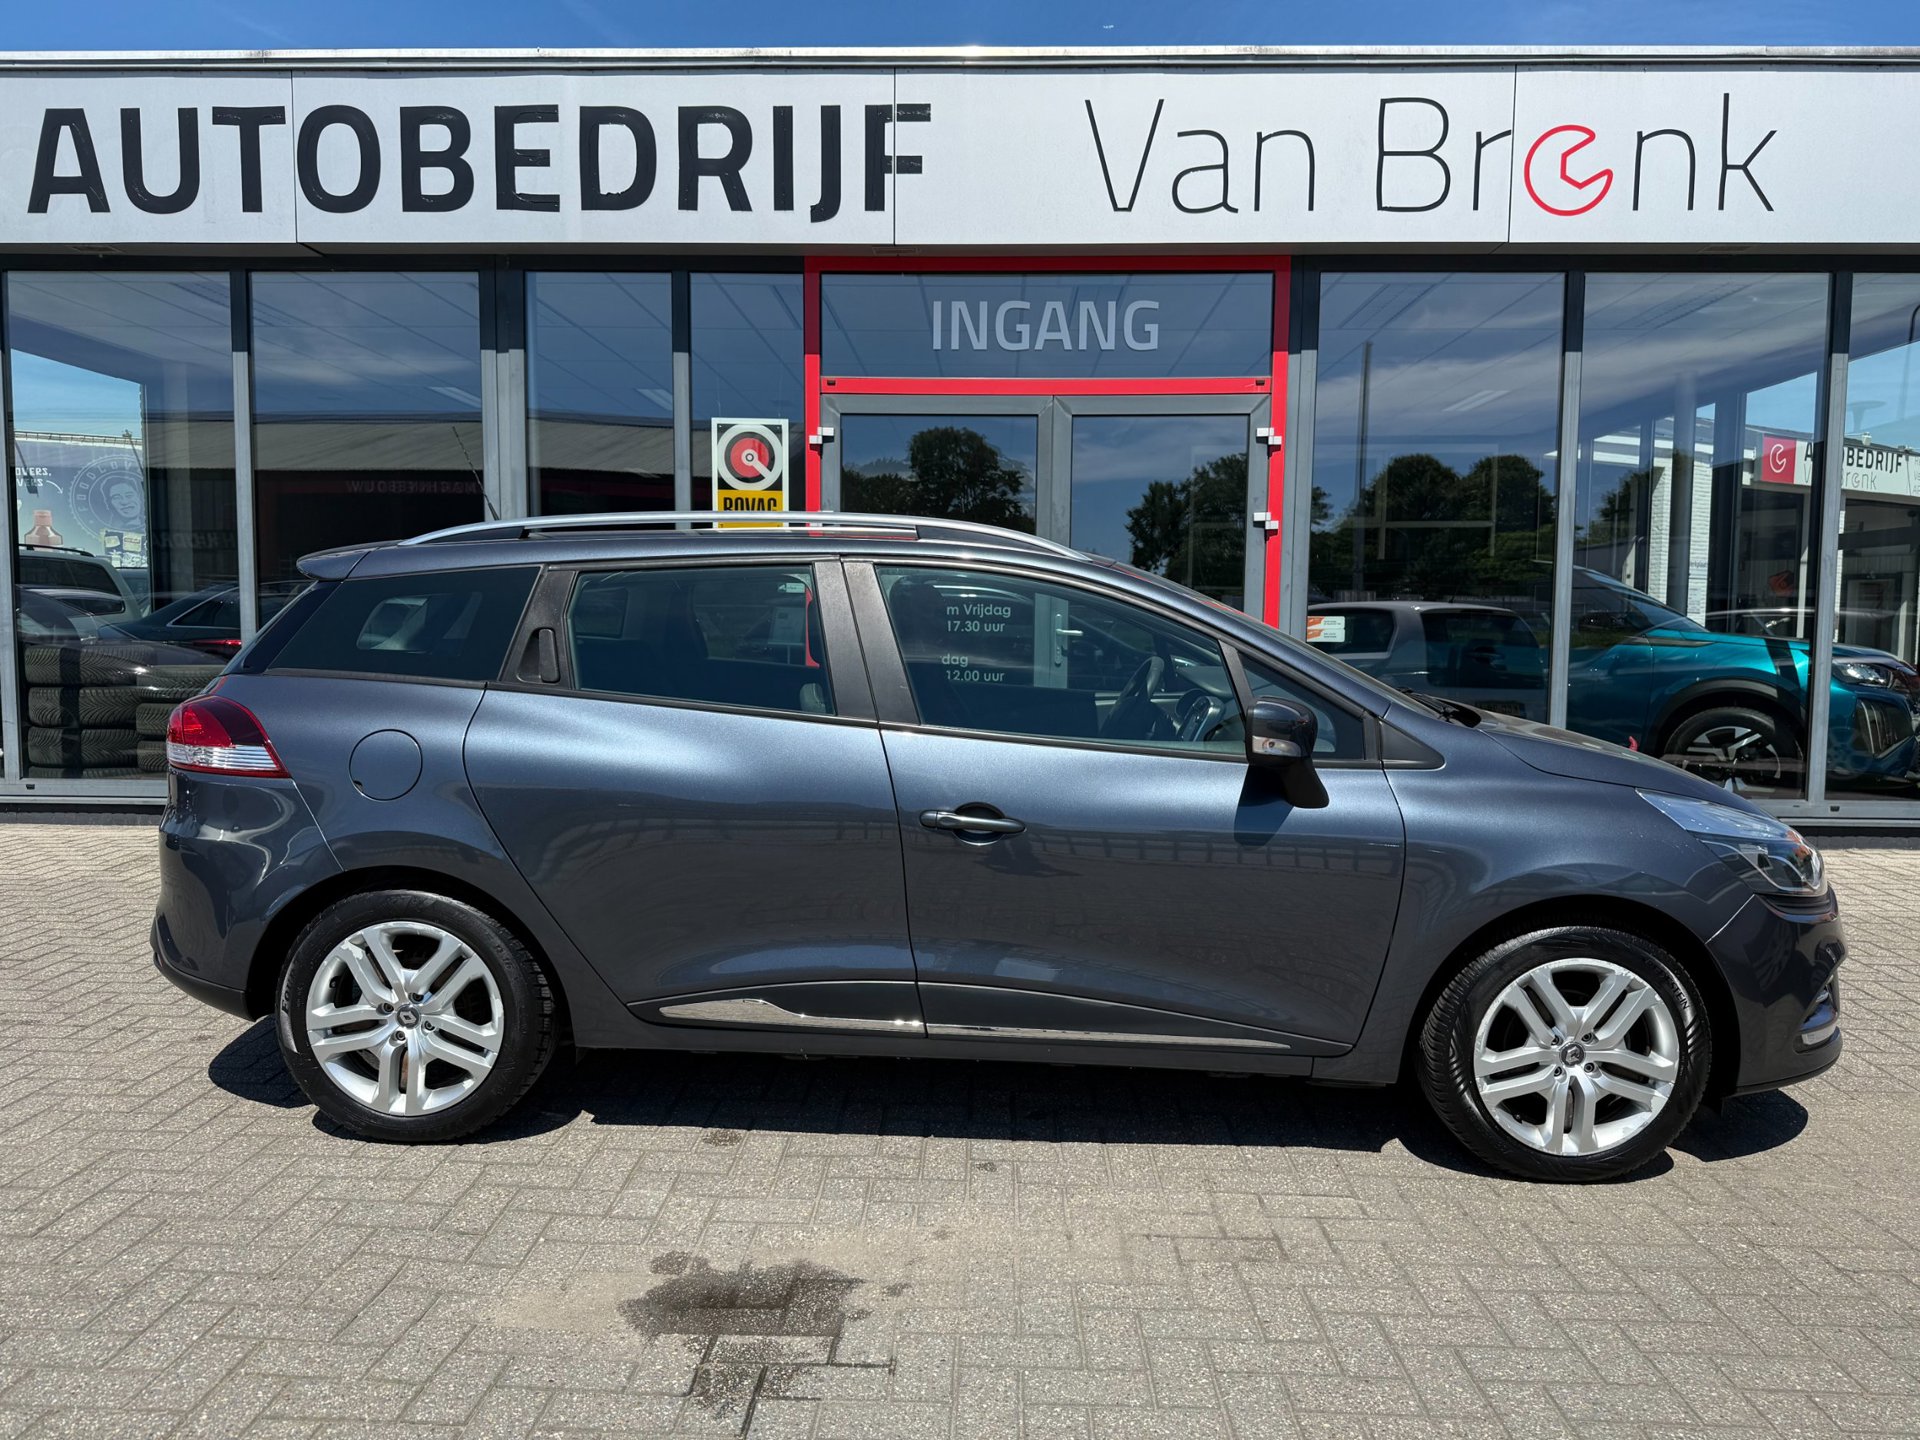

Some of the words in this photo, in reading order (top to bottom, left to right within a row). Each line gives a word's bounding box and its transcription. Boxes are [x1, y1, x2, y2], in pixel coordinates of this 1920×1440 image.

[27, 104, 932, 223] AUTOBEDRIJF
[1084, 98, 1316, 214] Van
[932, 299, 1160, 351] INGANG
[947, 621, 980, 632] 17.30
[984, 623, 1005, 632] uur
[963, 604, 1011, 618] Vrijdag
[946, 670, 979, 681] 12.00
[983, 672, 1005, 682] uur
